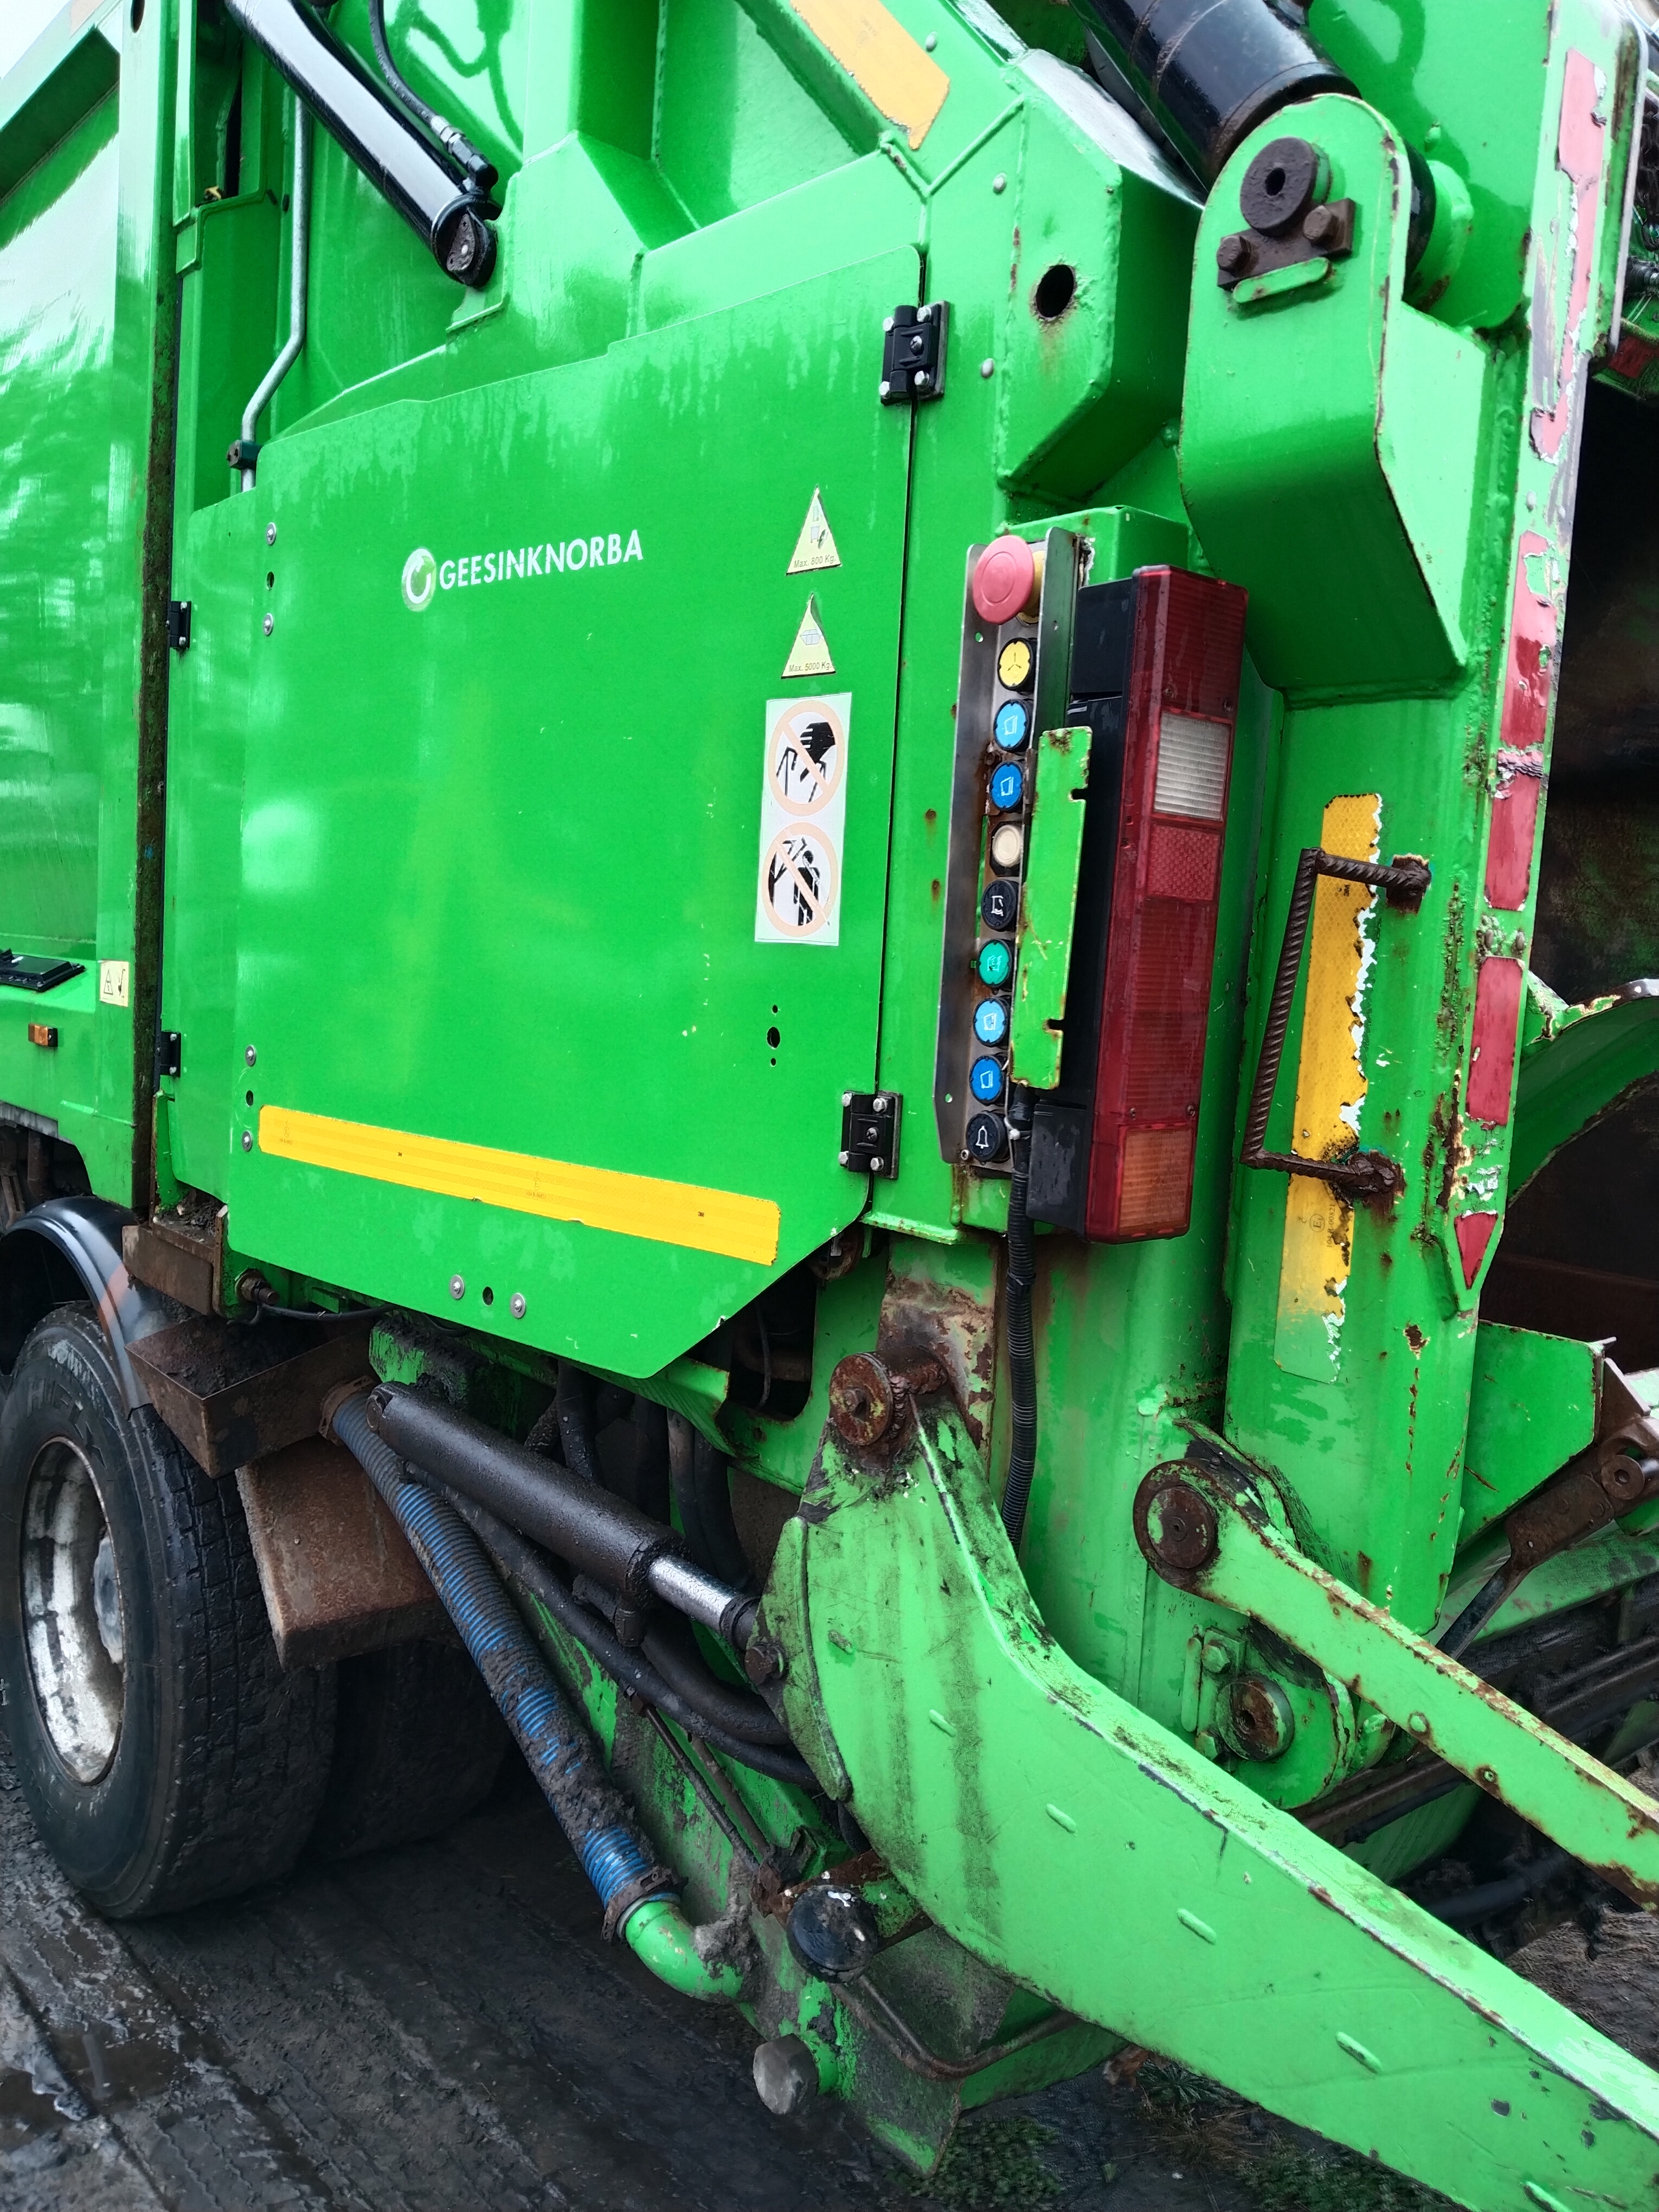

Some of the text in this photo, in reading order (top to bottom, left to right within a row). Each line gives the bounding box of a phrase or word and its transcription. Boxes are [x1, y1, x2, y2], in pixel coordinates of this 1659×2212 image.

[439, 529, 644, 590] GEESINKNORBA
[793, 554, 836, 568] Max. 800 Kg.
[789, 664, 803, 672] Max.
[805, 661, 820, 671] 5000
